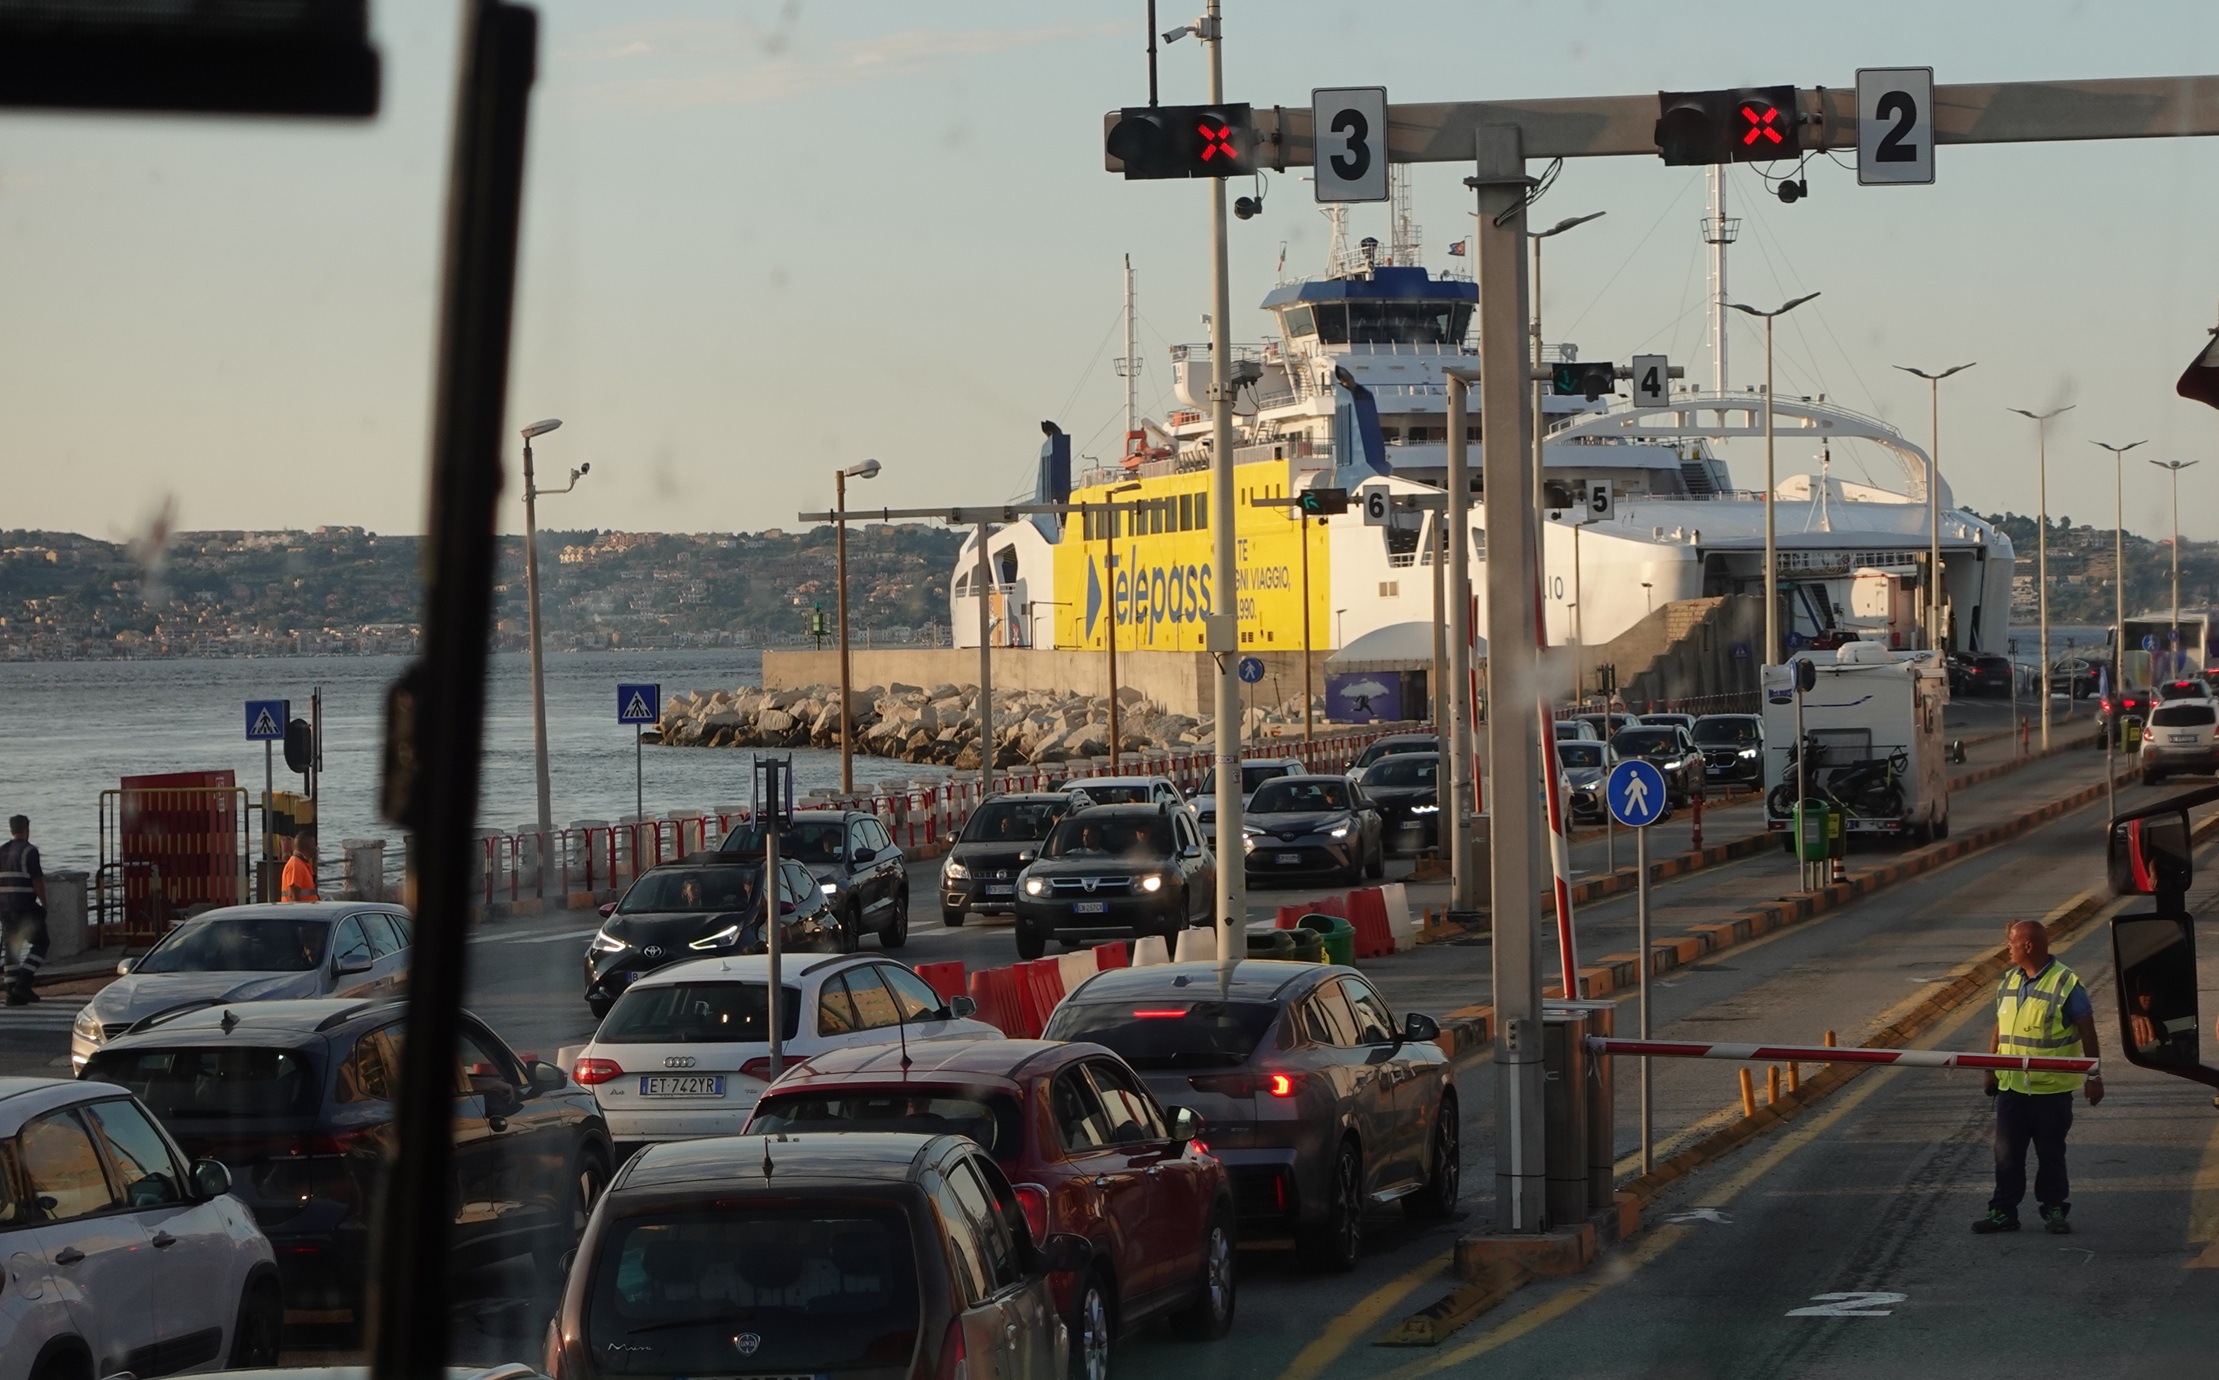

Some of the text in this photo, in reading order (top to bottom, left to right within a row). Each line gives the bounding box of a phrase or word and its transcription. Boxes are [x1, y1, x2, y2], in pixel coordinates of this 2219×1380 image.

[1875, 91, 1918, 163] 2
[1329, 108, 1371, 181] 3
[1641, 366, 1662, 398] 4
[1368, 492, 1385, 519] 6
[1592, 486, 1609, 513] 5
[1250, 566, 1291, 592] VIAGGIO,
[1237, 597, 1257, 620] 990.
